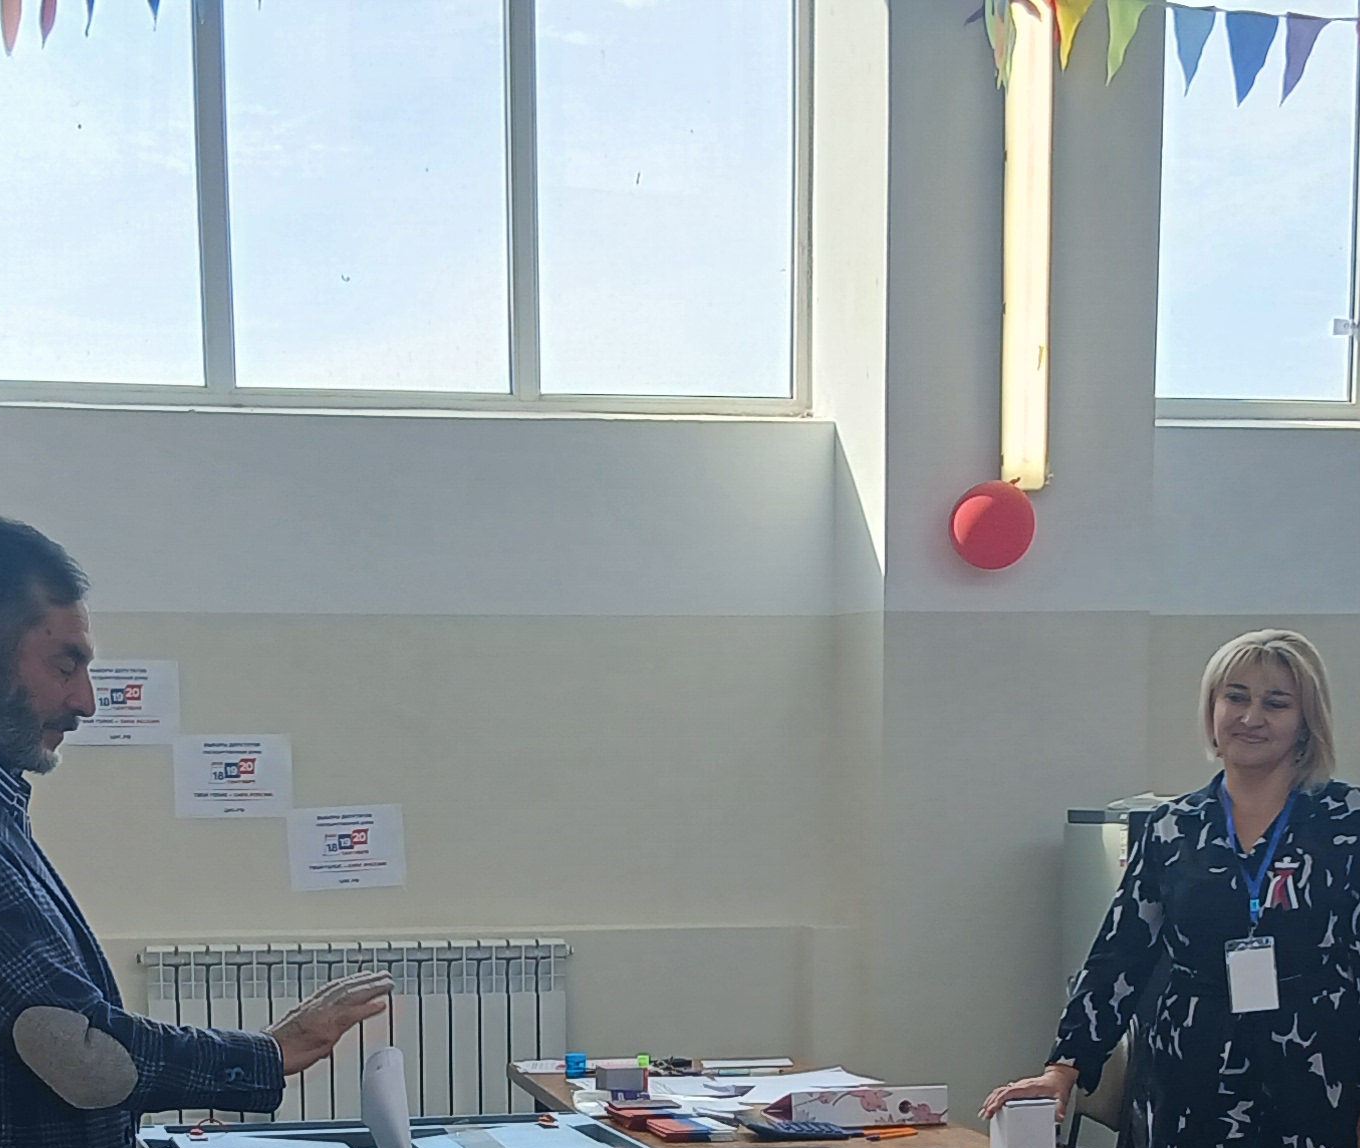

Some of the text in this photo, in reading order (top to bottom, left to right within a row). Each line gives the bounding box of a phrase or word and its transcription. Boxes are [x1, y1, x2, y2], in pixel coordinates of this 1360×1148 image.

[126, 688, 140, 698] 20
[212, 762, 254, 781] 18 19 20
[326, 843, 338, 852] 18
[352, 832, 367, 842] 20
